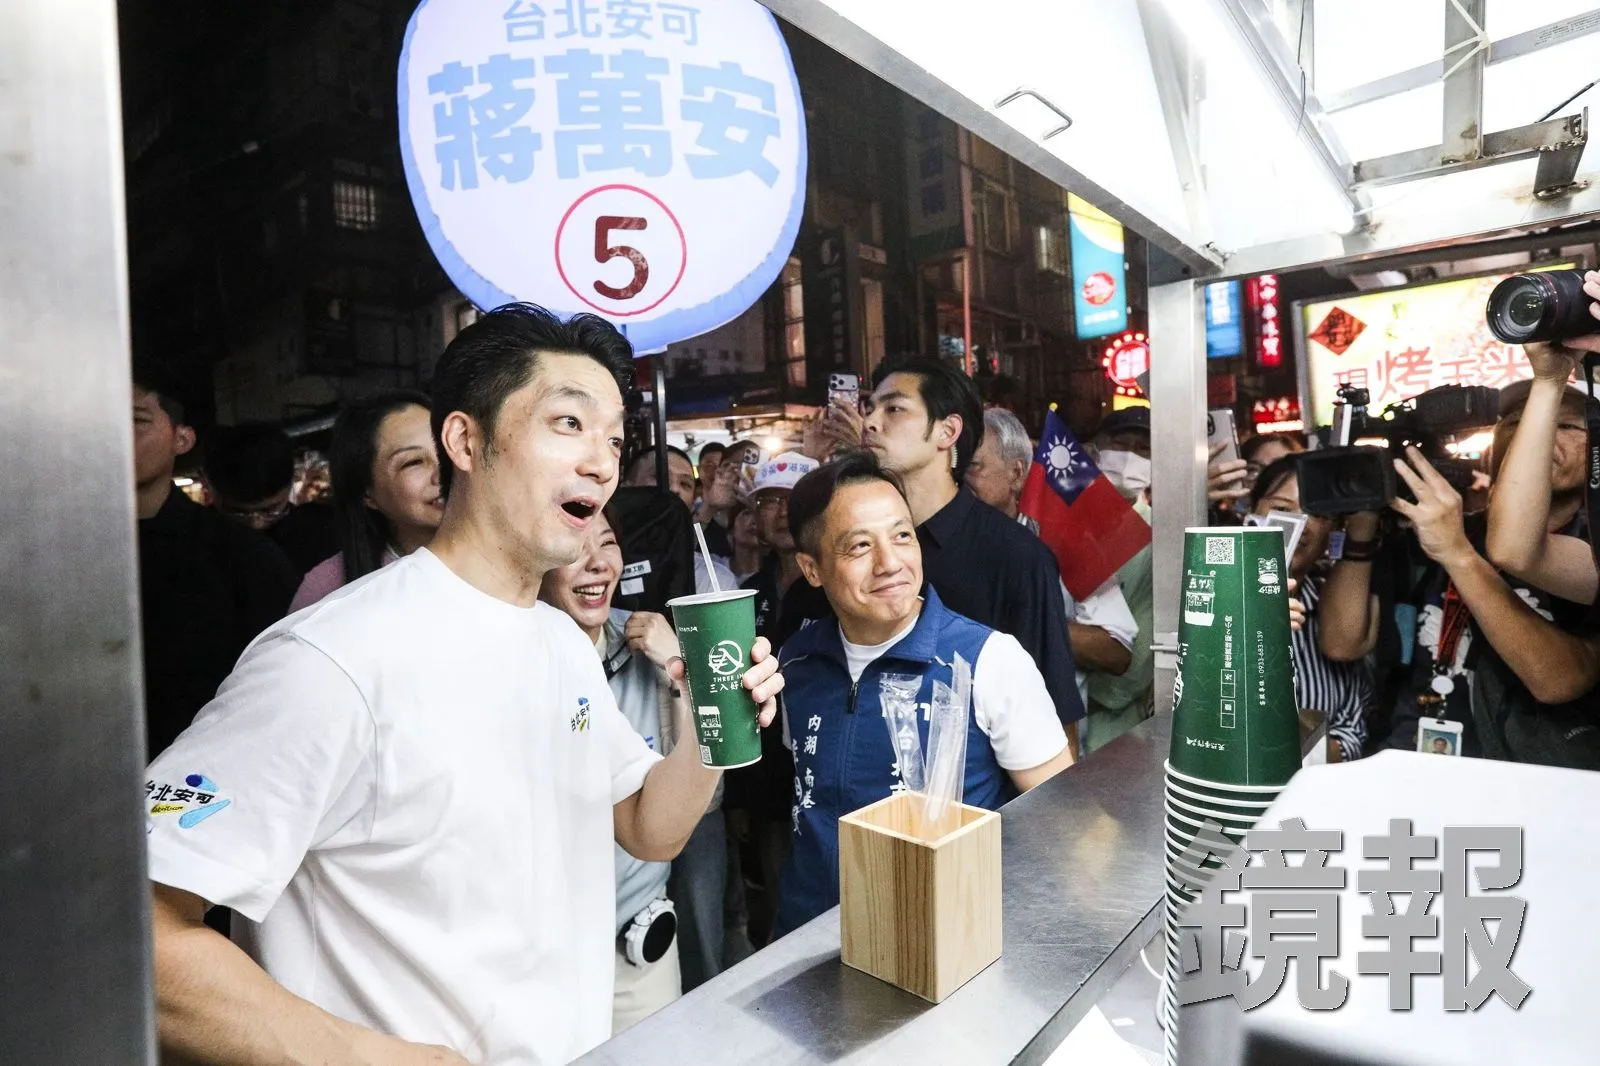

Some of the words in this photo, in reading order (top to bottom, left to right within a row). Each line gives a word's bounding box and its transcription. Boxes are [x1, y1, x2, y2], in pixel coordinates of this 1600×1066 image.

[502, 0, 702, 46] 台北安可
[427, 48, 782, 191] 蔣萬安
[593, 215, 650, 300] 5
[1590, 446, 1600, 489] Canon
